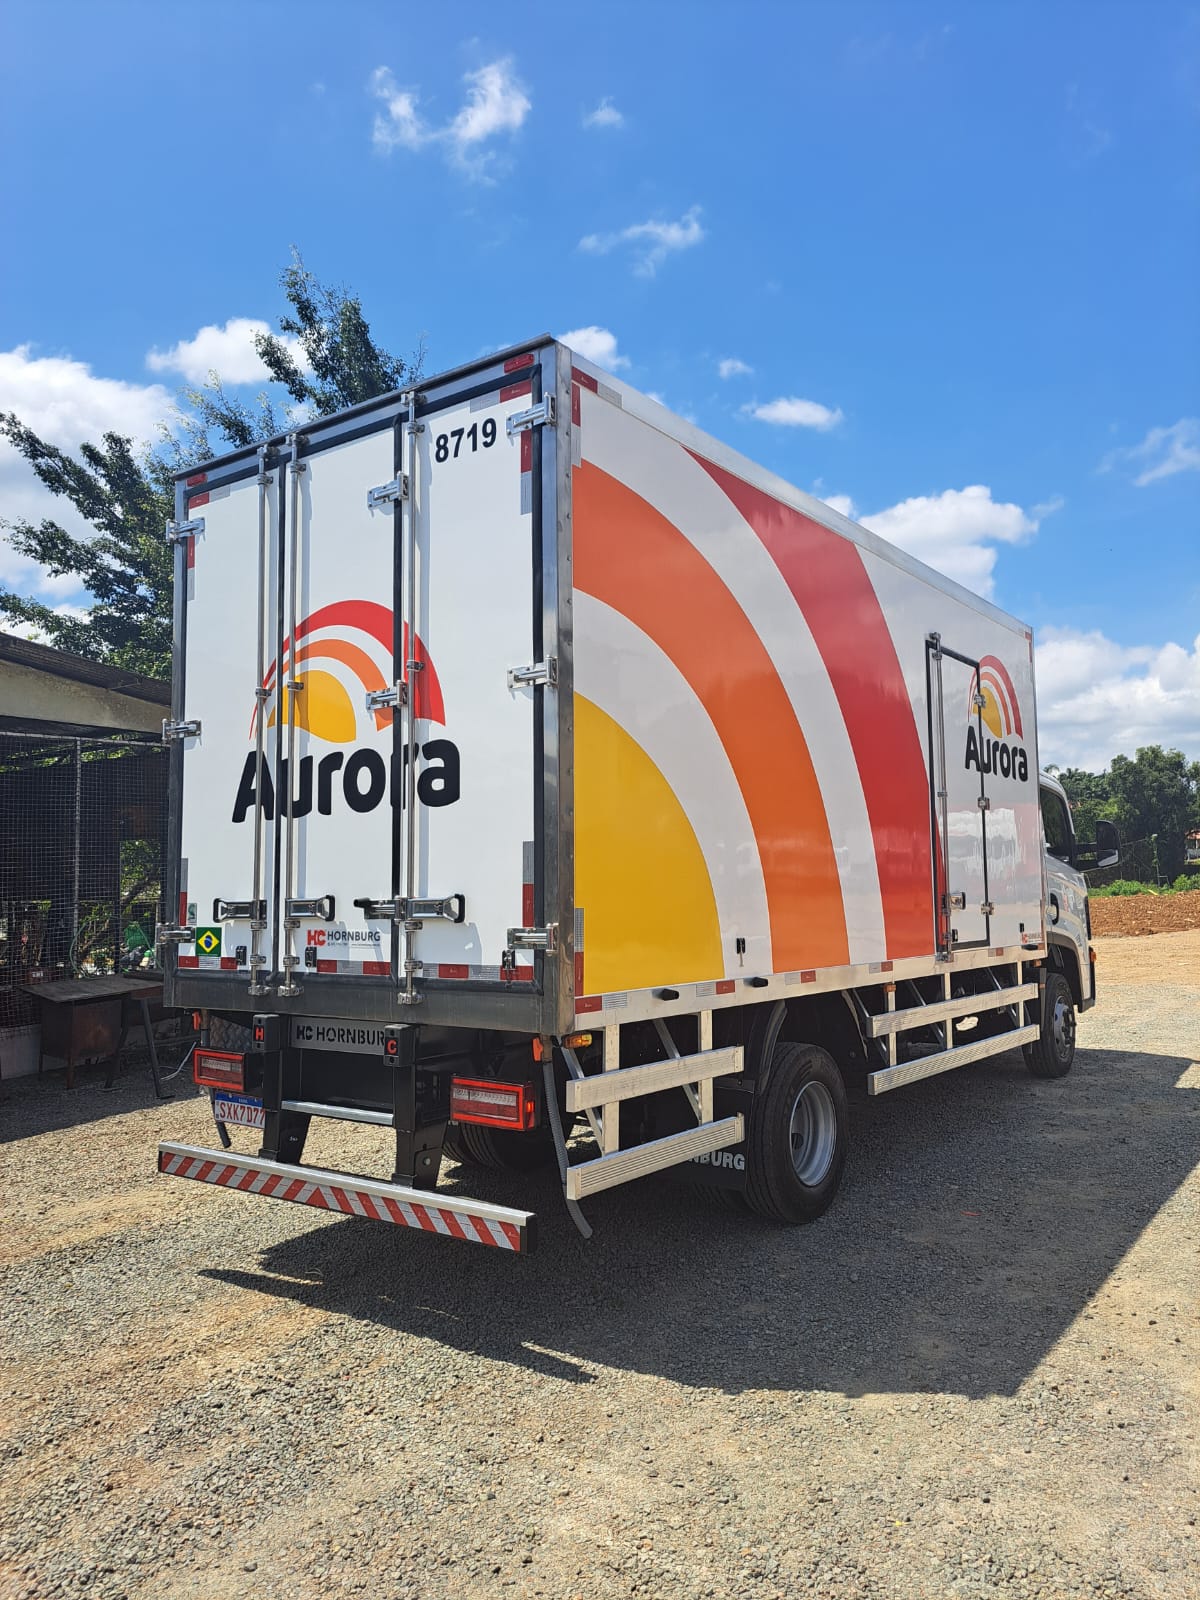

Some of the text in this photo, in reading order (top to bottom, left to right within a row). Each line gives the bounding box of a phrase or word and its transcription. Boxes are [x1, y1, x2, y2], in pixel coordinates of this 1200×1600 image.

[435, 418, 497, 463] 8719
[965, 725, 1028, 782] Aurora
[232, 739, 461, 823] Aurora
[307, 929, 326, 947] HC
[327, 930, 381, 941] HORNBURG
[296, 1025, 385, 1046] HC HORNBUR
